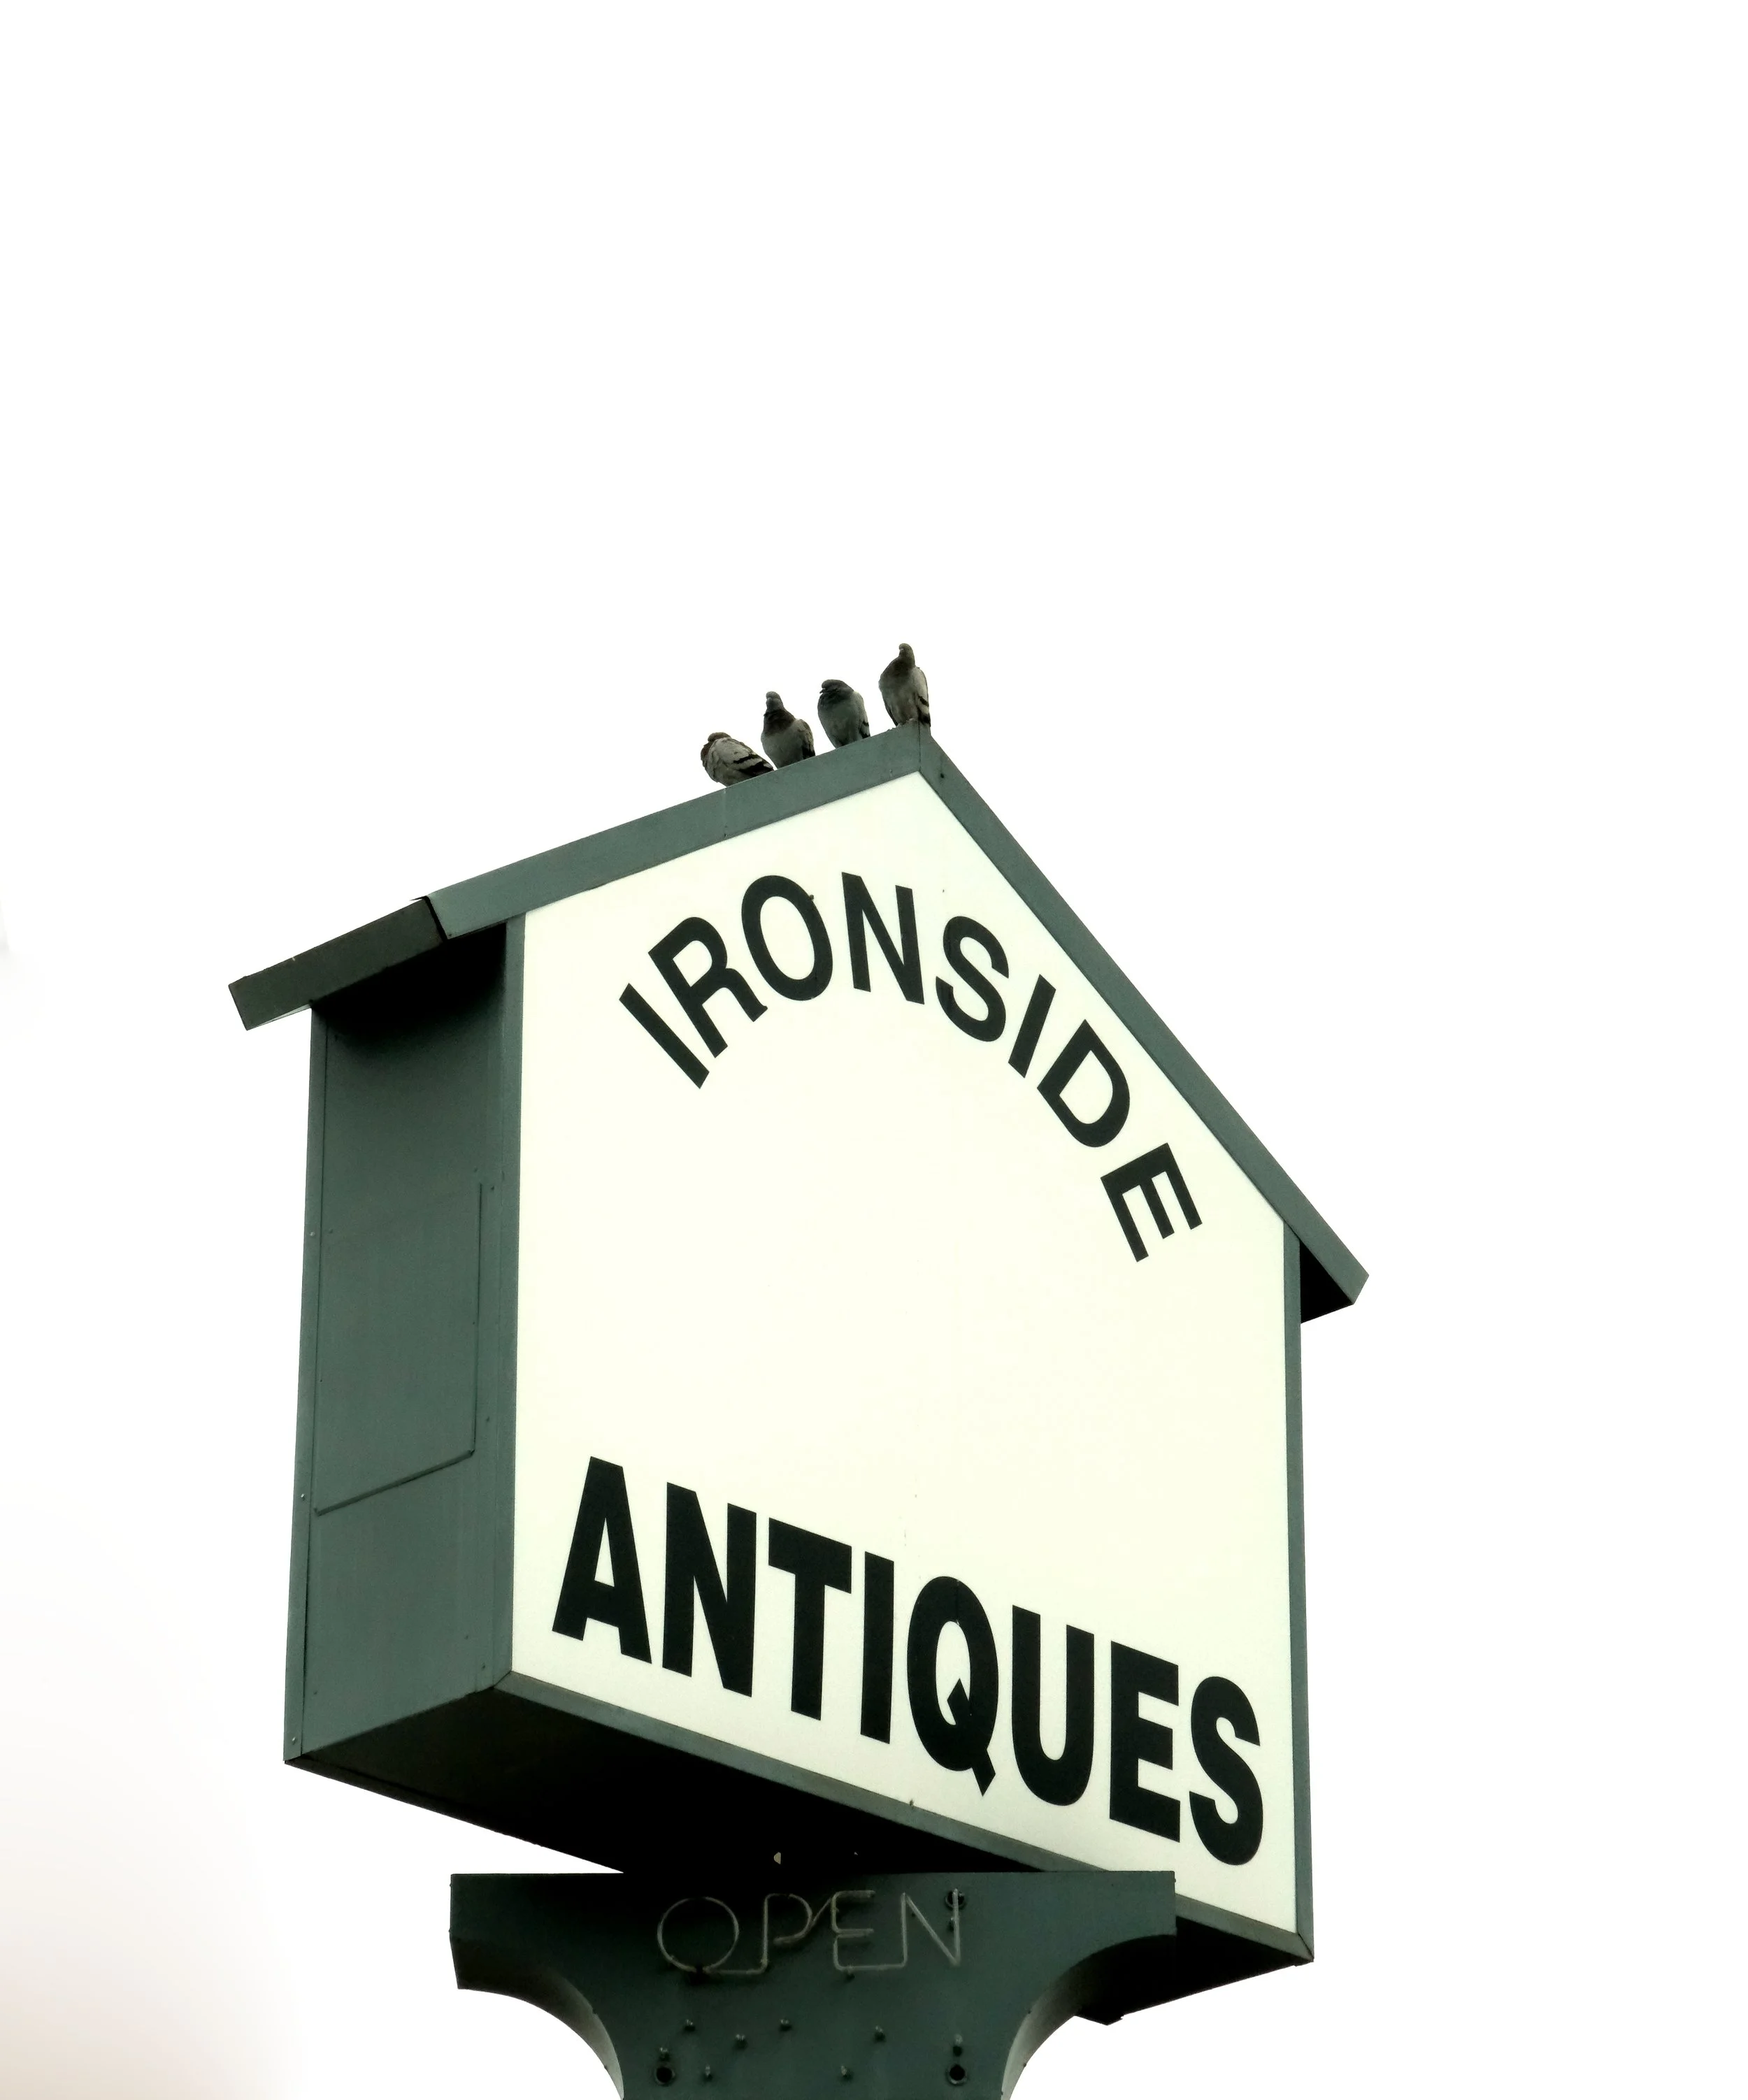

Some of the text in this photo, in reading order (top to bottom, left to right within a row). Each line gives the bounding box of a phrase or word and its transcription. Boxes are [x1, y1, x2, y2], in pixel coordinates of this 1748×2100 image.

[619, 872, 1202, 1262] IRONSIDE
[552, 1457, 1263, 1865] ANTIQUES
[657, 1889, 962, 1973] OPEN
